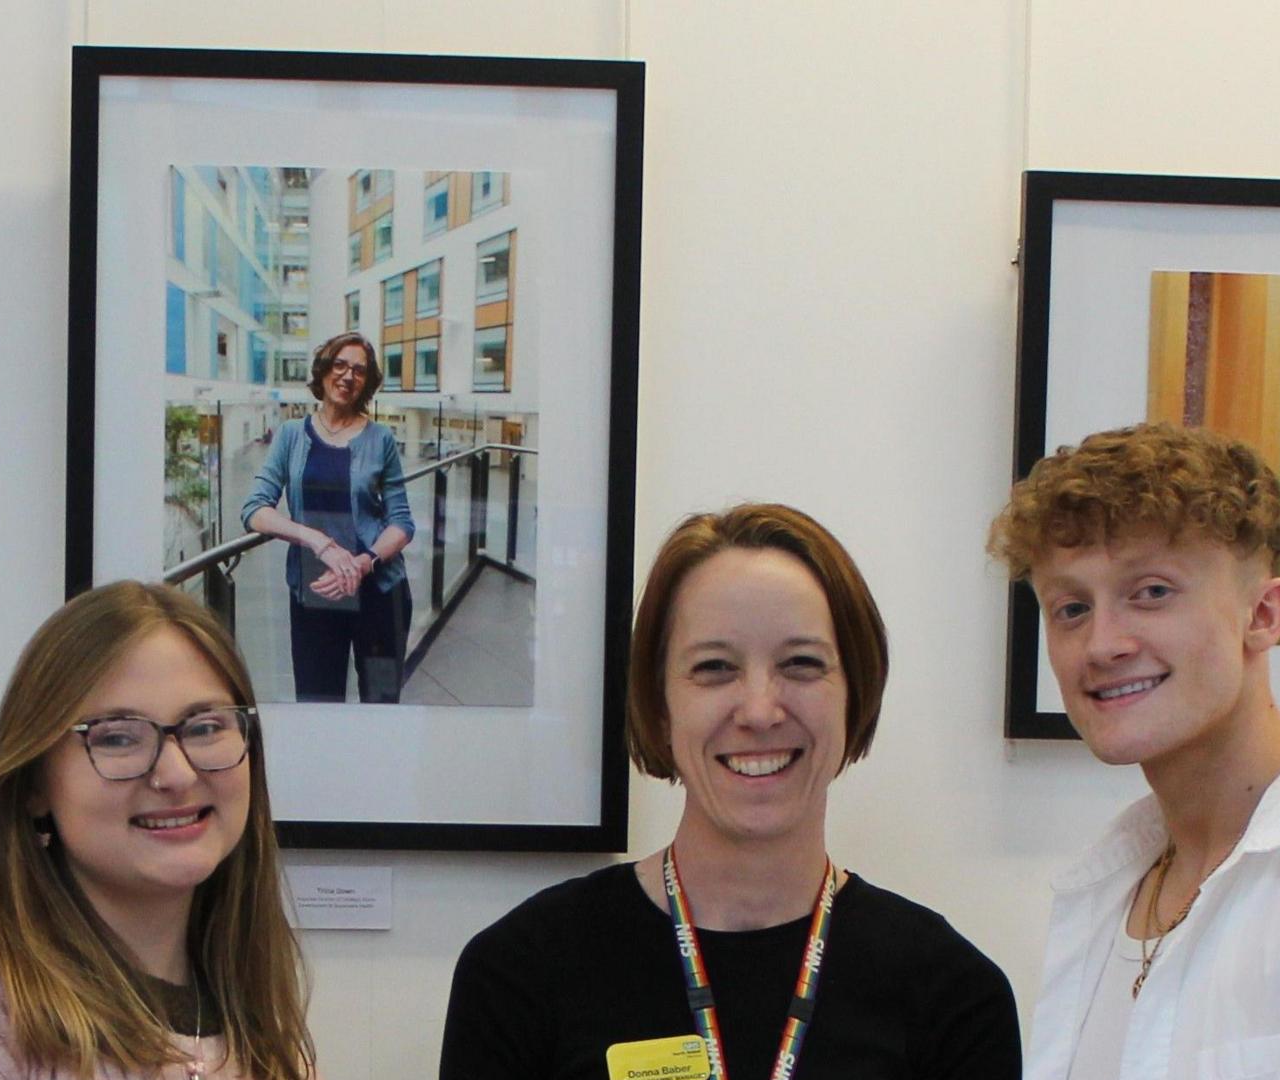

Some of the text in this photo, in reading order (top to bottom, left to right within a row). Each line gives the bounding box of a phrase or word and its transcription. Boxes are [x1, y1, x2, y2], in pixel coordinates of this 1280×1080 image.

[664, 862, 681, 896] NHS
[819, 880, 835, 914] NHS
[674, 923, 698, 958] NHS
[805, 935, 825, 973] NHS
[628, 1065, 691, 1078] Donna Baber
